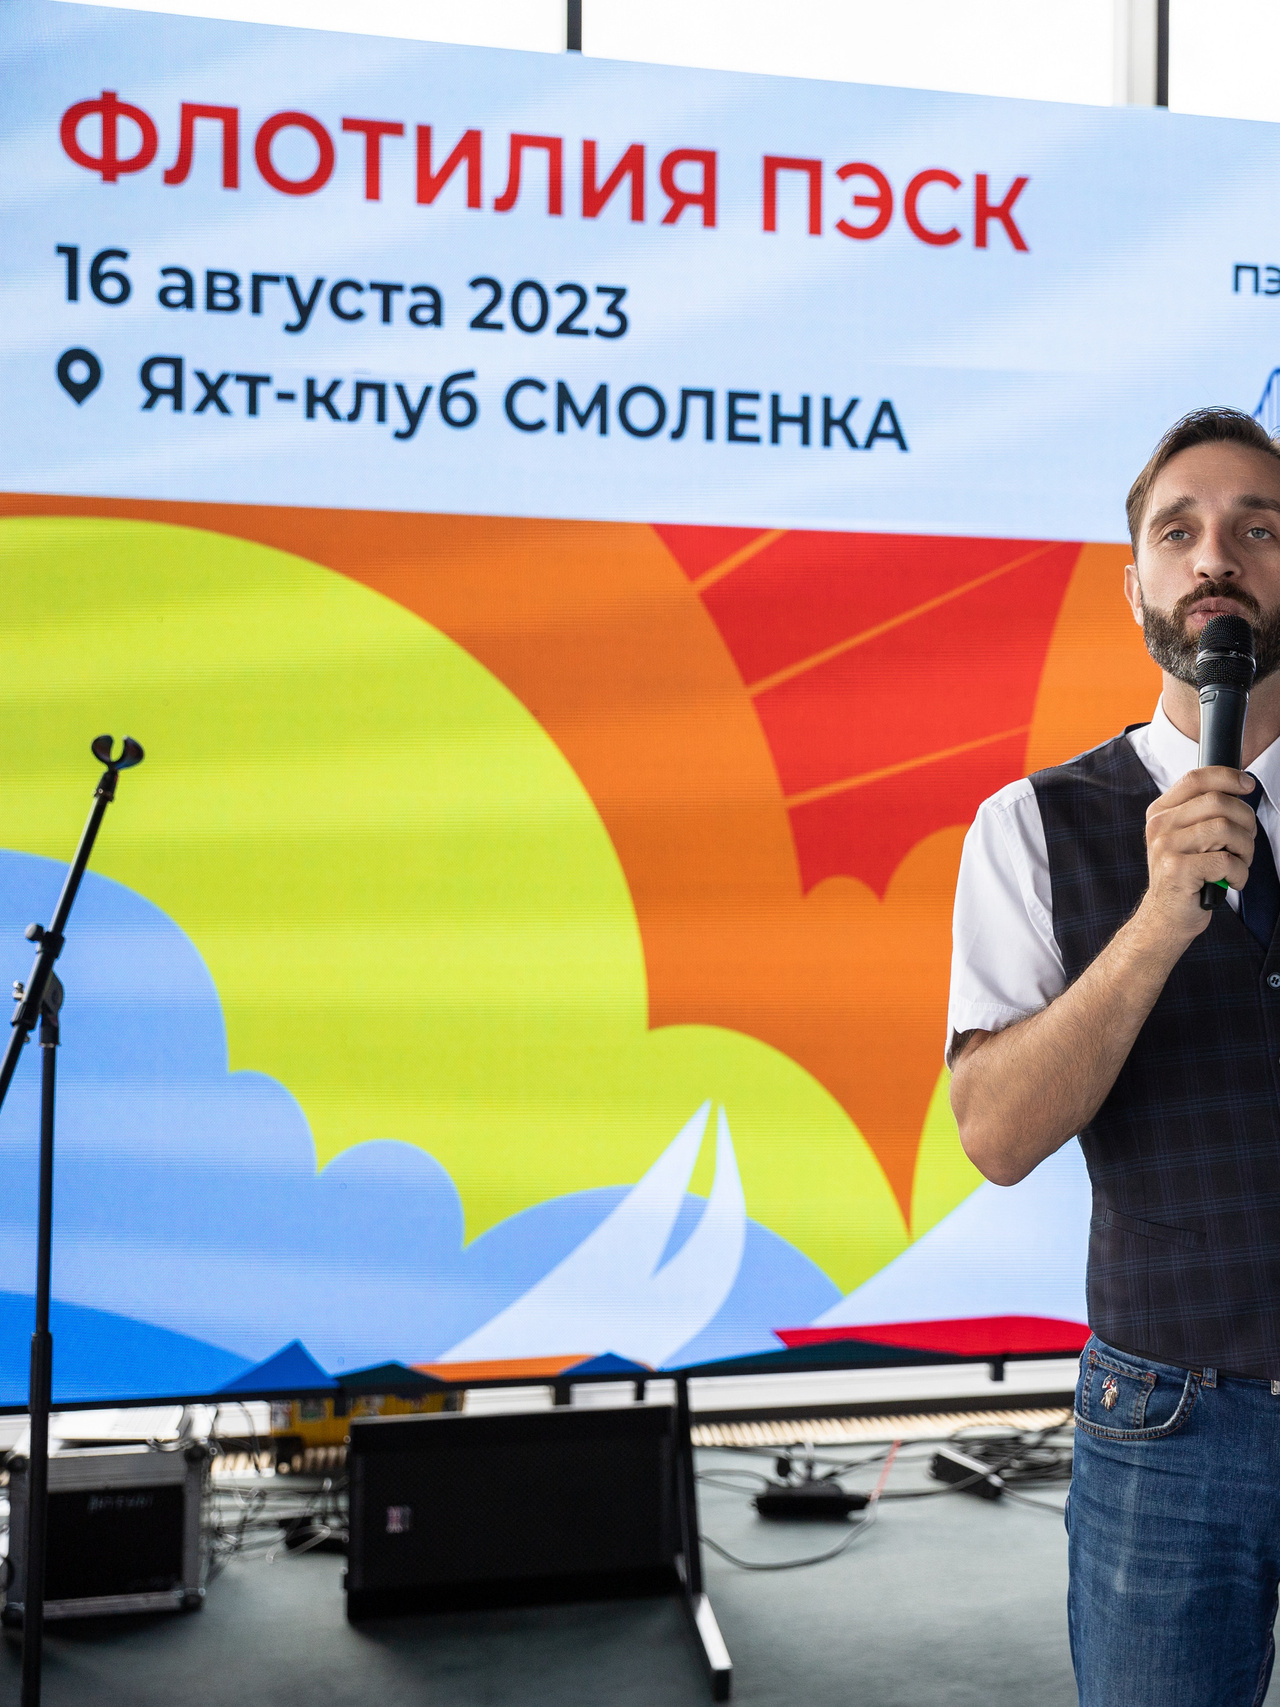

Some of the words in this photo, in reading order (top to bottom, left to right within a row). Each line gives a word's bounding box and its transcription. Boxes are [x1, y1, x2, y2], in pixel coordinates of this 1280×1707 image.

[59, 90, 717, 229] ФЛОТИЛИЯ
[762, 154, 1030, 253] ПЭСК
[55, 244, 132, 306] 16
[157, 264, 443, 333] августа
[468, 276, 629, 340] 2023
[139, 355, 479, 440] Яхт-клуб
[503, 377, 909, 452] СМОЛЕНКА
